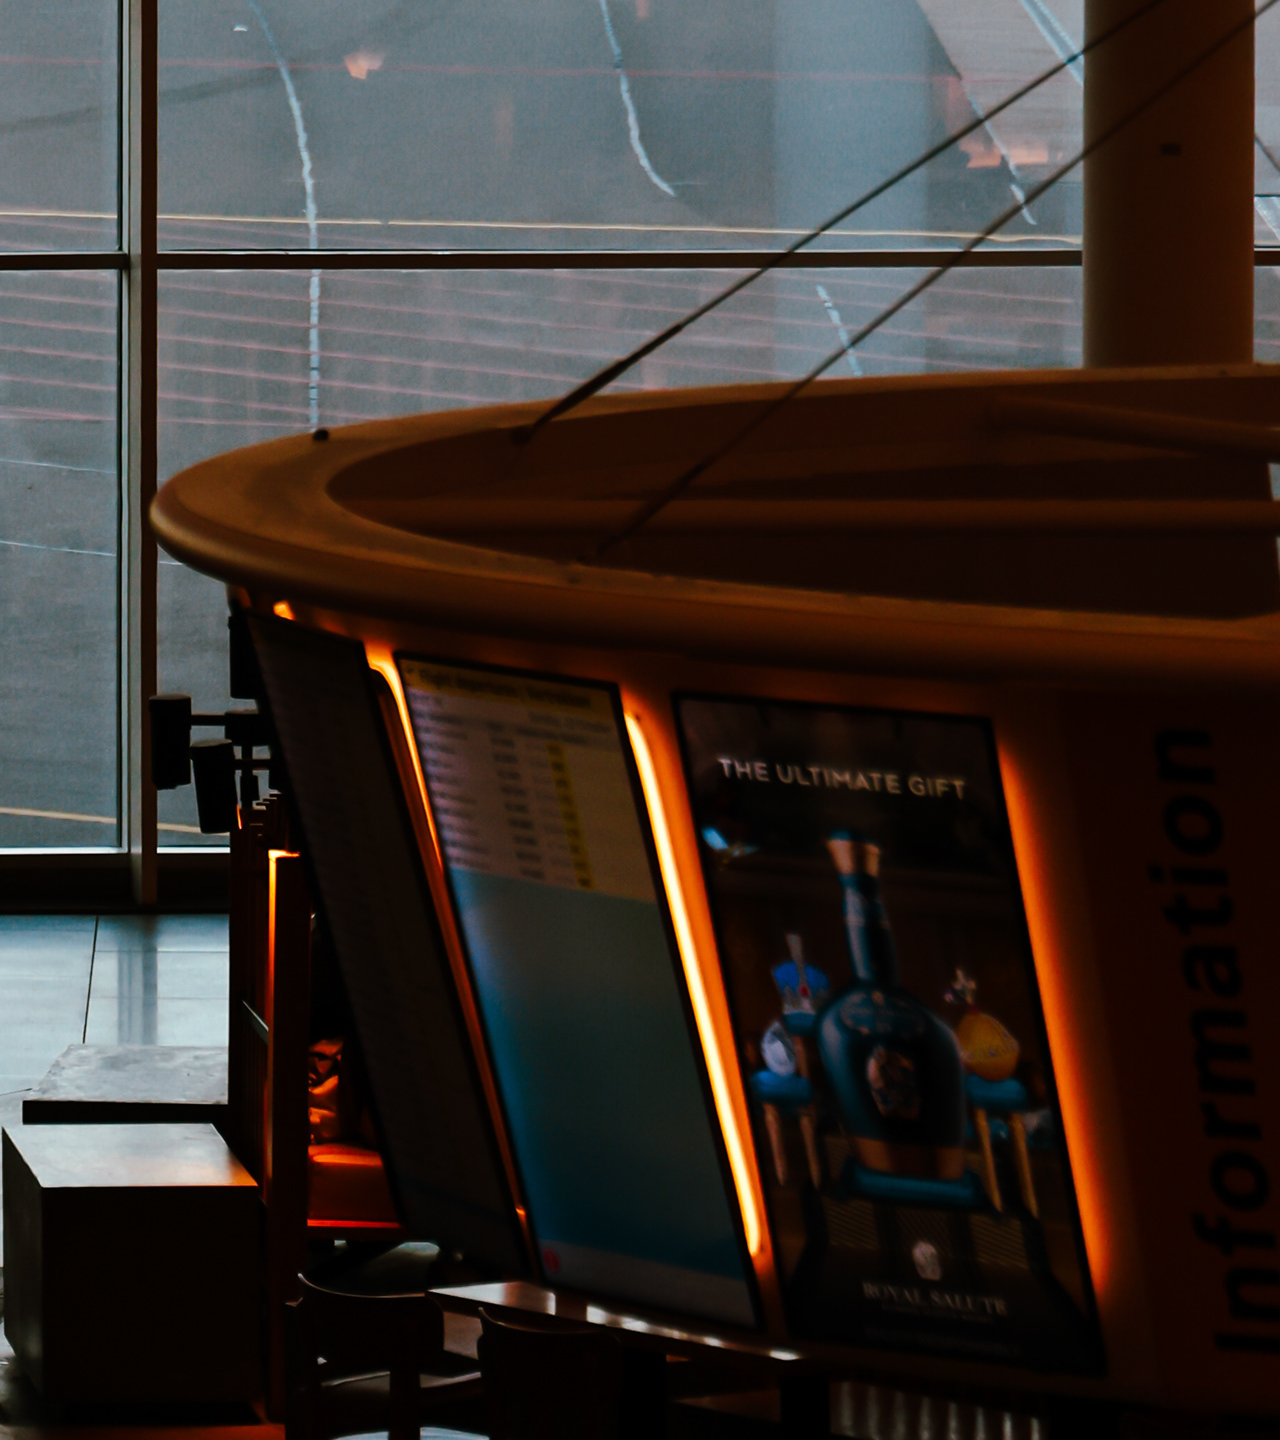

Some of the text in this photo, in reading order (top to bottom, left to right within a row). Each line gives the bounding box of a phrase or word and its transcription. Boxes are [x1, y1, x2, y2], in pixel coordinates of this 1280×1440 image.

[717, 753, 967, 801] THE ULTIMATE GIFT
[1153, 725, 1280, 1354] Information
